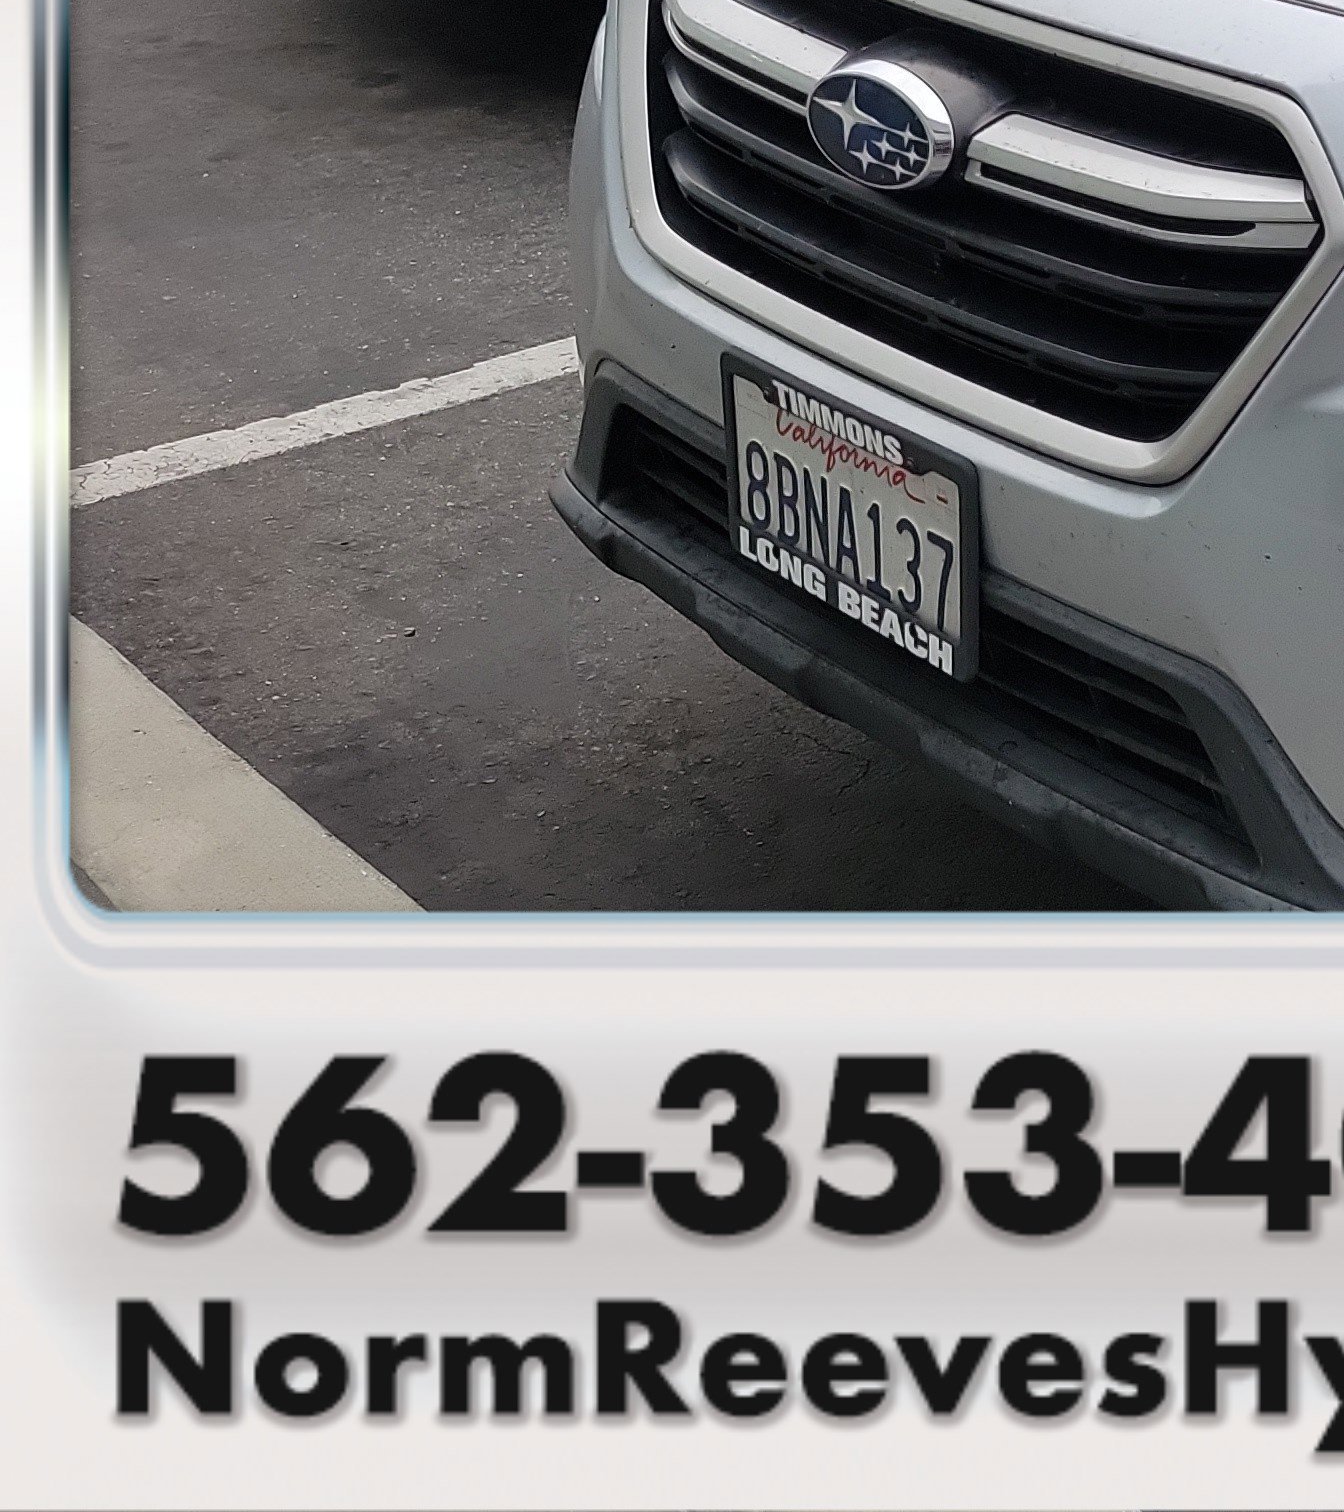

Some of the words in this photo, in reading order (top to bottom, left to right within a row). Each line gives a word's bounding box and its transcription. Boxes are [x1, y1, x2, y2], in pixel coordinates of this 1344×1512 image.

[772, 379, 903, 466] TIMMONS
[775, 409, 926, 504] California
[745, 440, 954, 632] 8BNA137
[739, 525, 827, 602] LONG
[838, 580, 953, 676] BEACH
